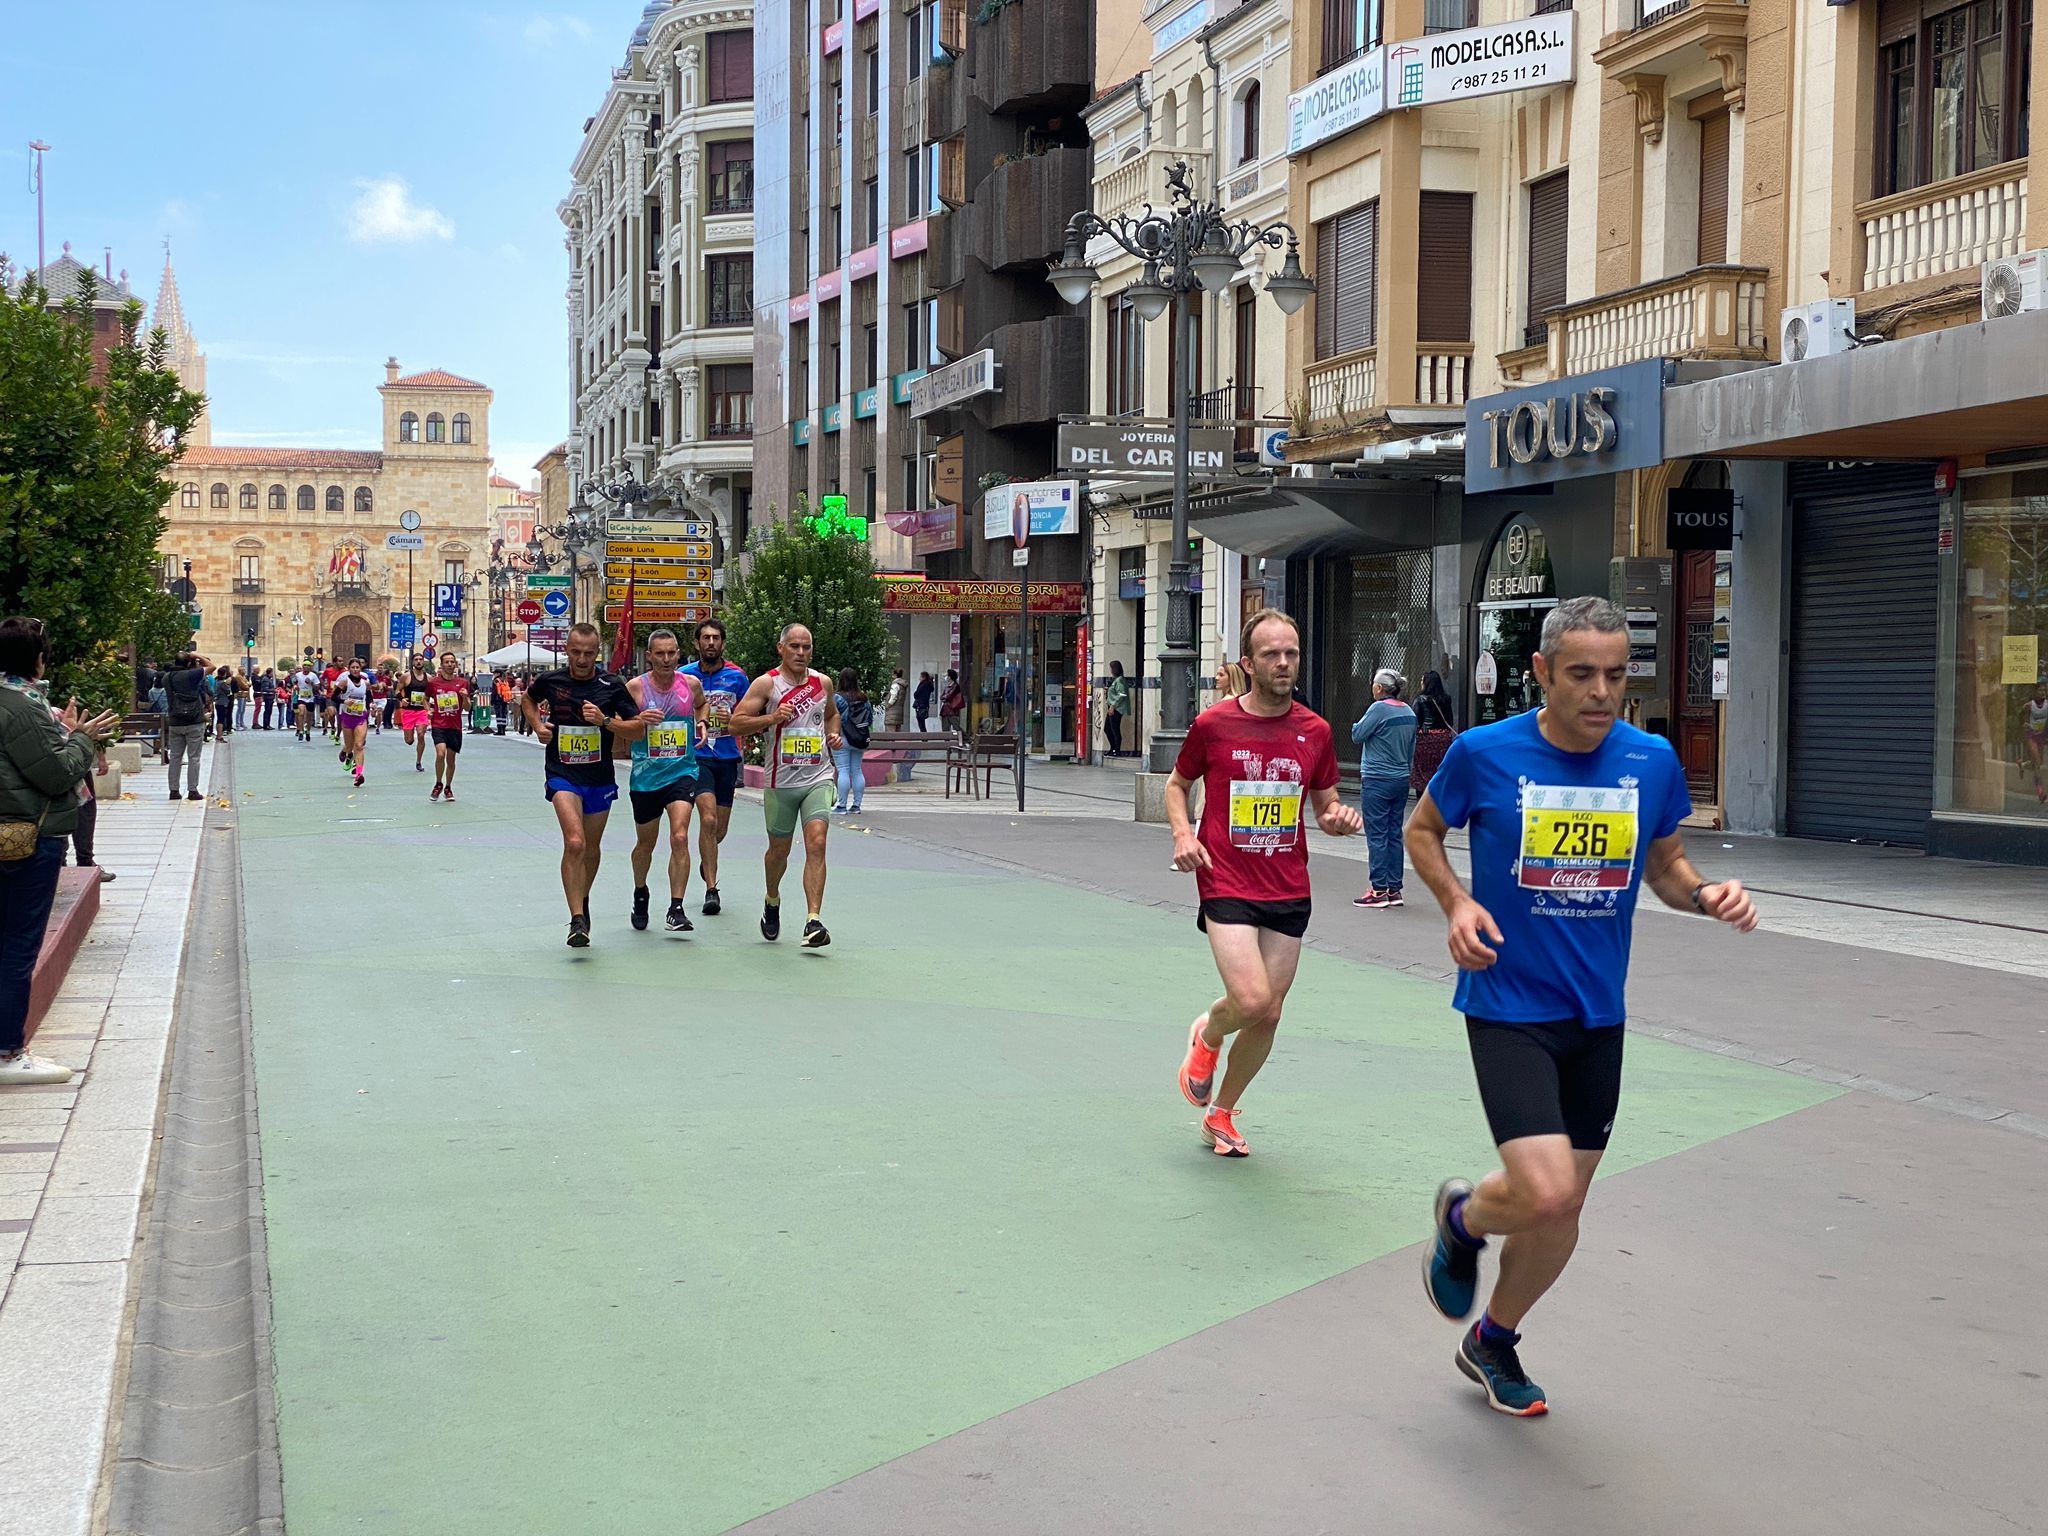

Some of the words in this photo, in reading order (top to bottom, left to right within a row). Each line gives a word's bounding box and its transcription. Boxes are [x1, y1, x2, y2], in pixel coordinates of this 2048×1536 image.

[1464, 72, 1487, 89] 987
[1492, 69, 1508, 84] 25
[1514, 67, 1526, 81] 11
[1532, 63, 1547, 78] 21
[1482, 387, 1617, 468] TOUS
[1120, 432, 1175, 443] JOYERIA
[1071, 447, 1114, 464] DEL
[1127, 448, 1223, 467] CAREN
[1674, 512, 1729, 526] TOUS
[389, 535, 422, 546] Cámara
[1510, 536, 1523, 554] BE
[637, 545, 655, 553] Luna
[641, 566, 659, 575] León
[1121, 568, 1145, 579] ESTRELLA
[886, 583, 950, 594] ROYAL
[958, 584, 1059, 595] TANDOORI
[1490, 579, 1503, 596] BE
[1505, 575, 1544, 594] BEAUTY
[438, 585, 451, 607] P
[647, 588, 677, 596] Antonio
[787, 684, 815, 705] DESPENSA
[795, 697, 816, 715] FER
[570, 739, 589, 751] 143
[660, 734, 676, 746] 154
[794, 740, 811, 753] 156
[1232, 750, 1250, 758] 2022
[1253, 803, 1281, 825] 179
[1572, 813, 1592, 821] HUGO
[1552, 822, 1608, 857] 236
[1531, 906, 1575, 917] BENAVIDES
[1576, 909, 1588, 917] DE
